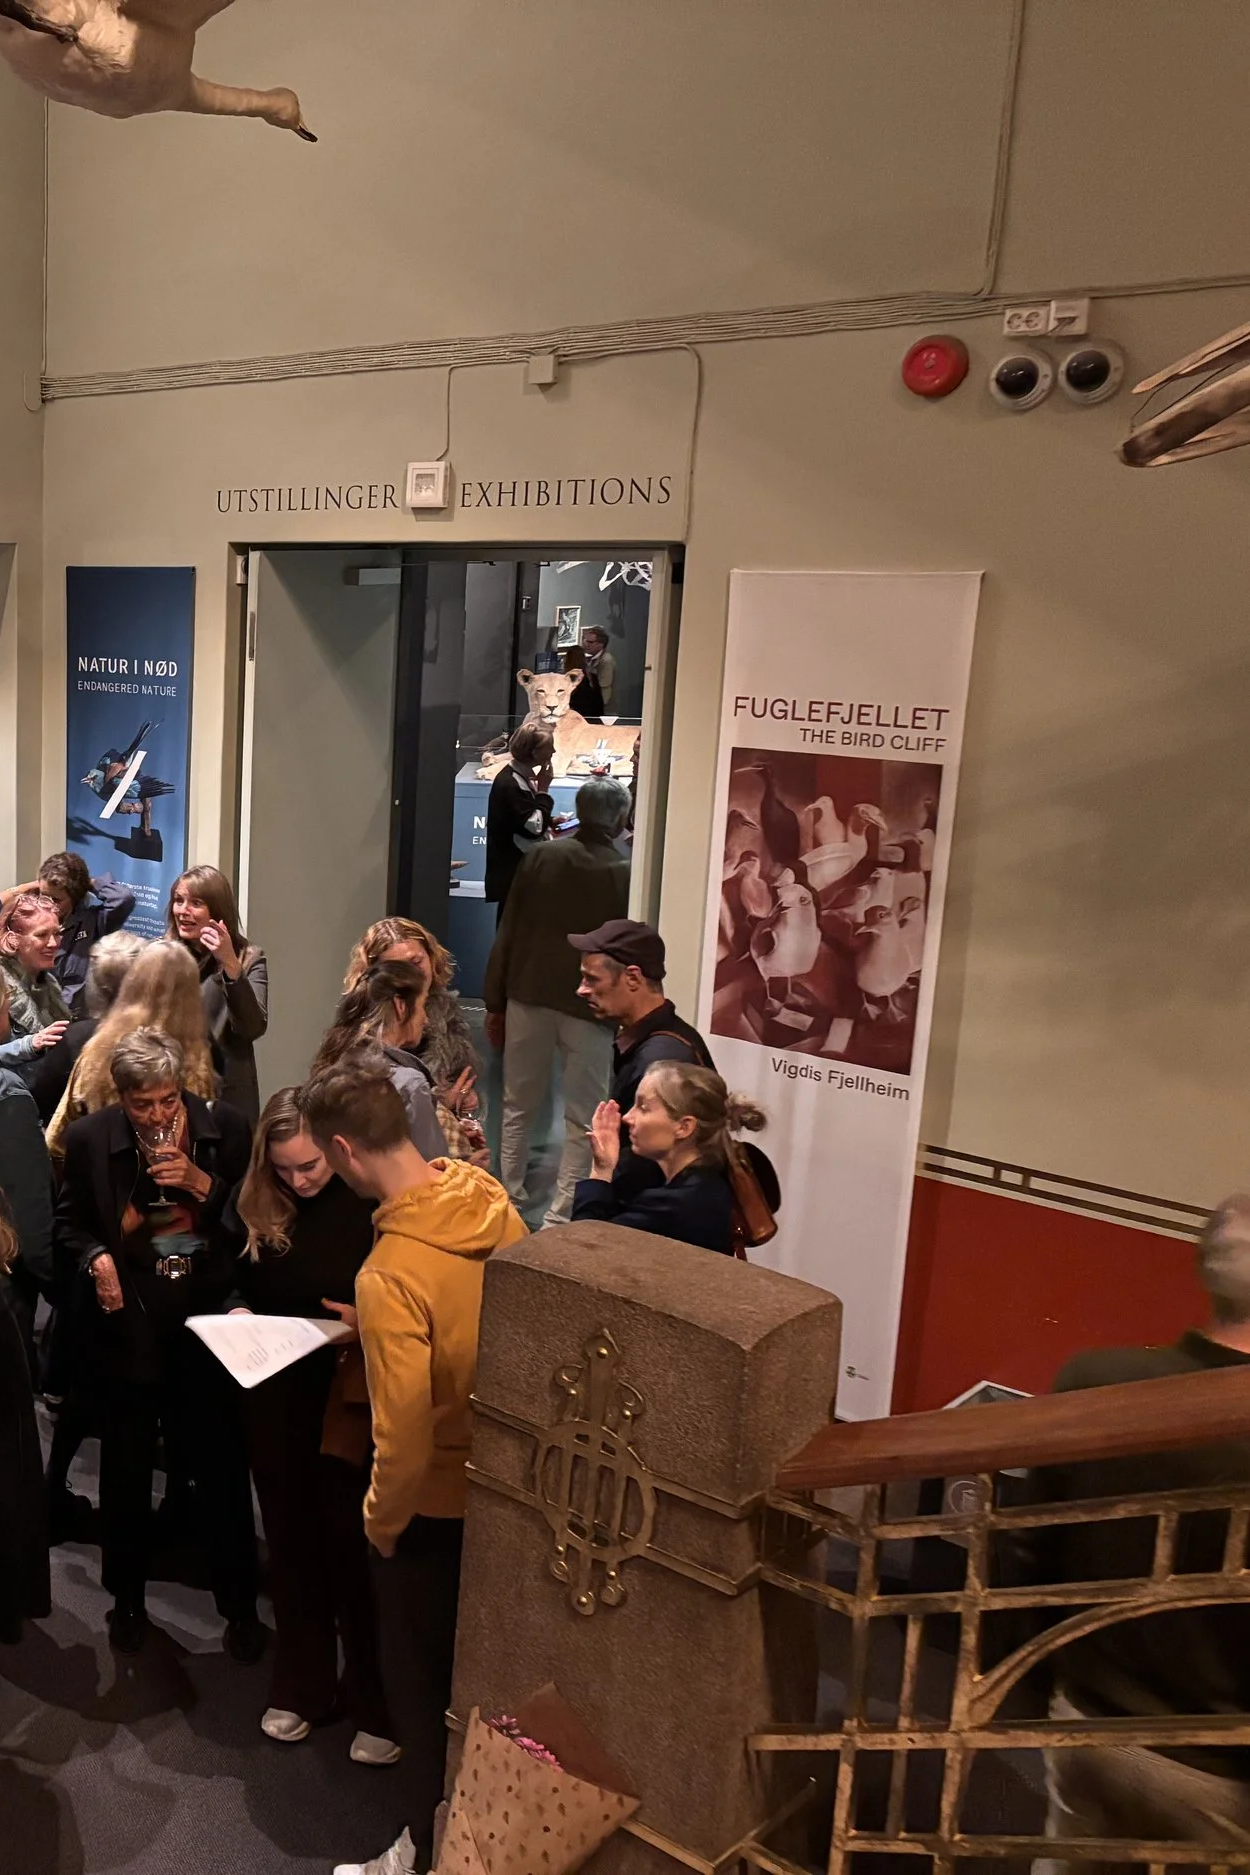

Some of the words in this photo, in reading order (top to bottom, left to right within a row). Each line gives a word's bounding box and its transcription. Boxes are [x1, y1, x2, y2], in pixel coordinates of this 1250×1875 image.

[217, 484, 400, 513] UTSTILLINGER
[460, 476, 672, 508] EXHIBITIONS
[78, 656, 128, 674] NATUR
[134, 659, 138, 675] I
[144, 660, 178, 677] NØD
[77, 680, 139, 694] ENDANGERED
[141, 684, 177, 697] NATURE
[734, 696, 950, 731] FUGLEFJELLET
[800, 728, 836, 744] THE
[841, 731, 885, 748] BIRD
[890, 735, 947, 752] CLIFF
[772, 1057, 822, 1082] Vigdis
[827, 1069, 910, 1101] Fjellheim
